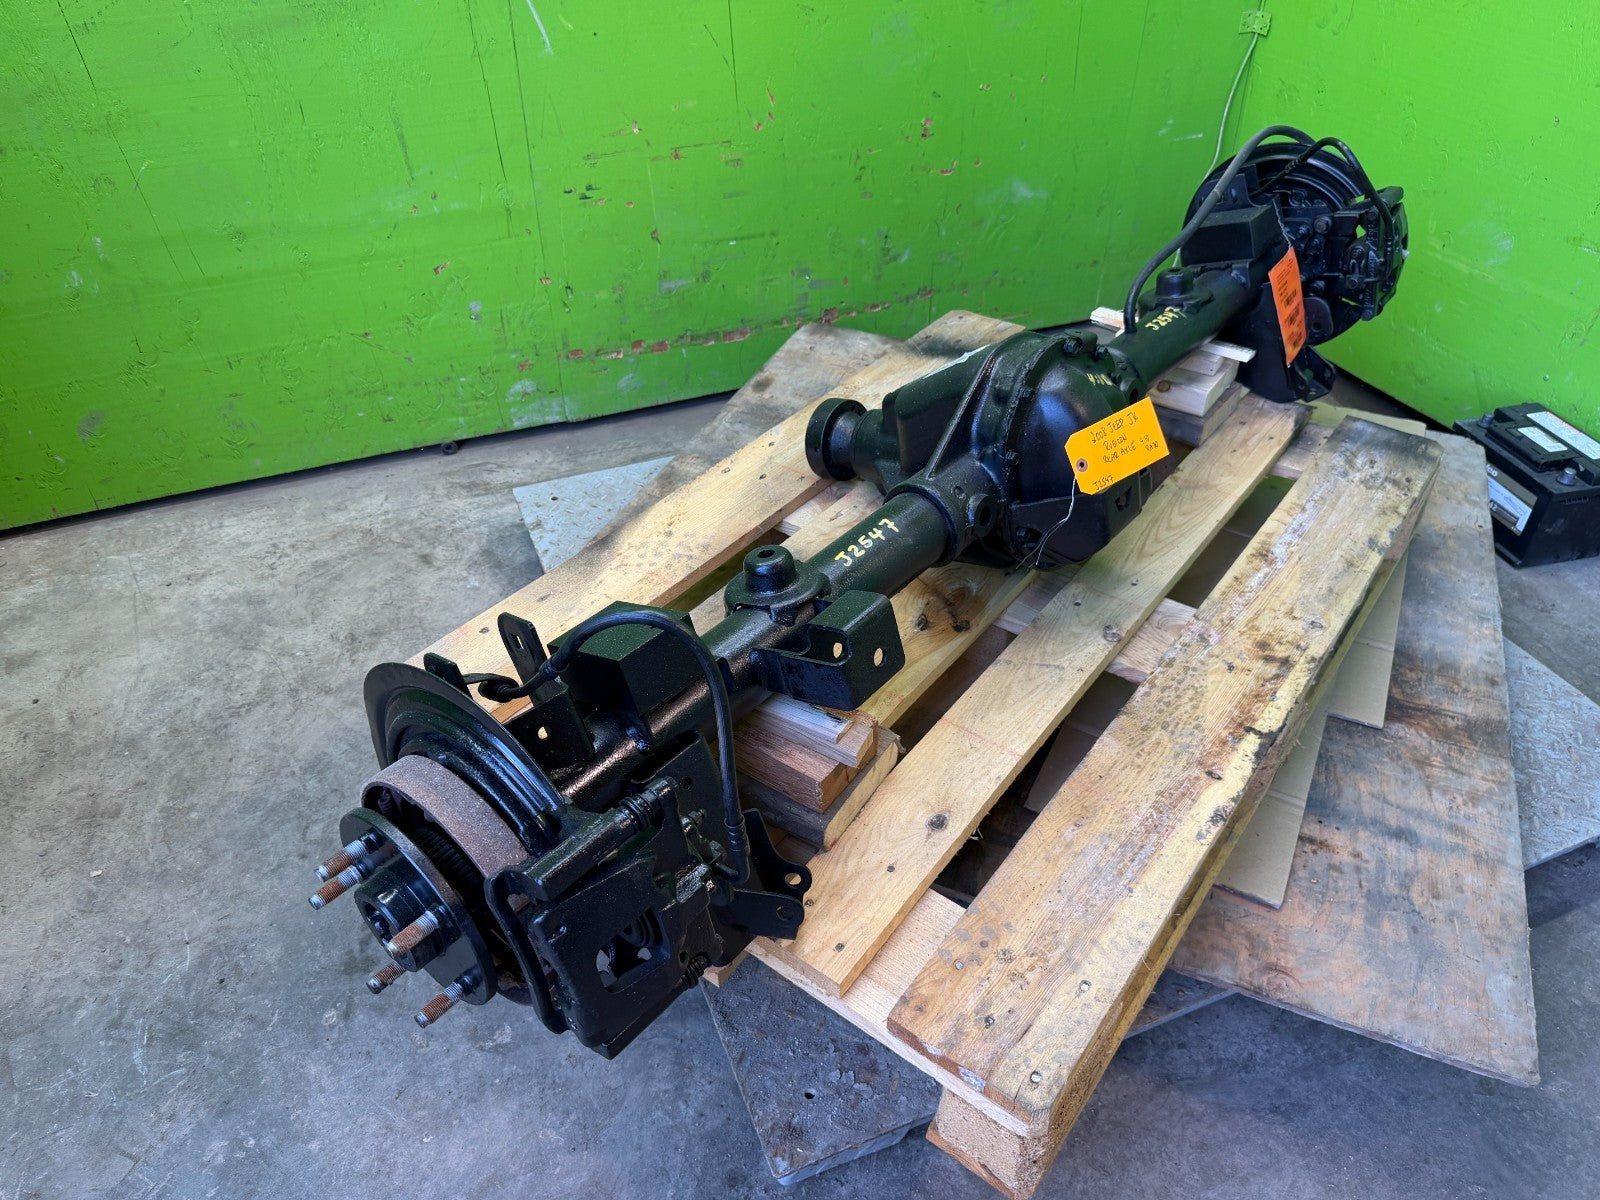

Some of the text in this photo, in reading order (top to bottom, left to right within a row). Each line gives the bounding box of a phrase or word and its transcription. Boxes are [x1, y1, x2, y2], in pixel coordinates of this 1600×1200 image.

[1145, 306, 1186, 331] J2547
[1090, 412, 1139, 443] 2008 JEEP JK
[1120, 440, 1137, 456] AXLE
[1092, 475, 1114, 490] J2547
[834, 518, 899, 567] J2547
